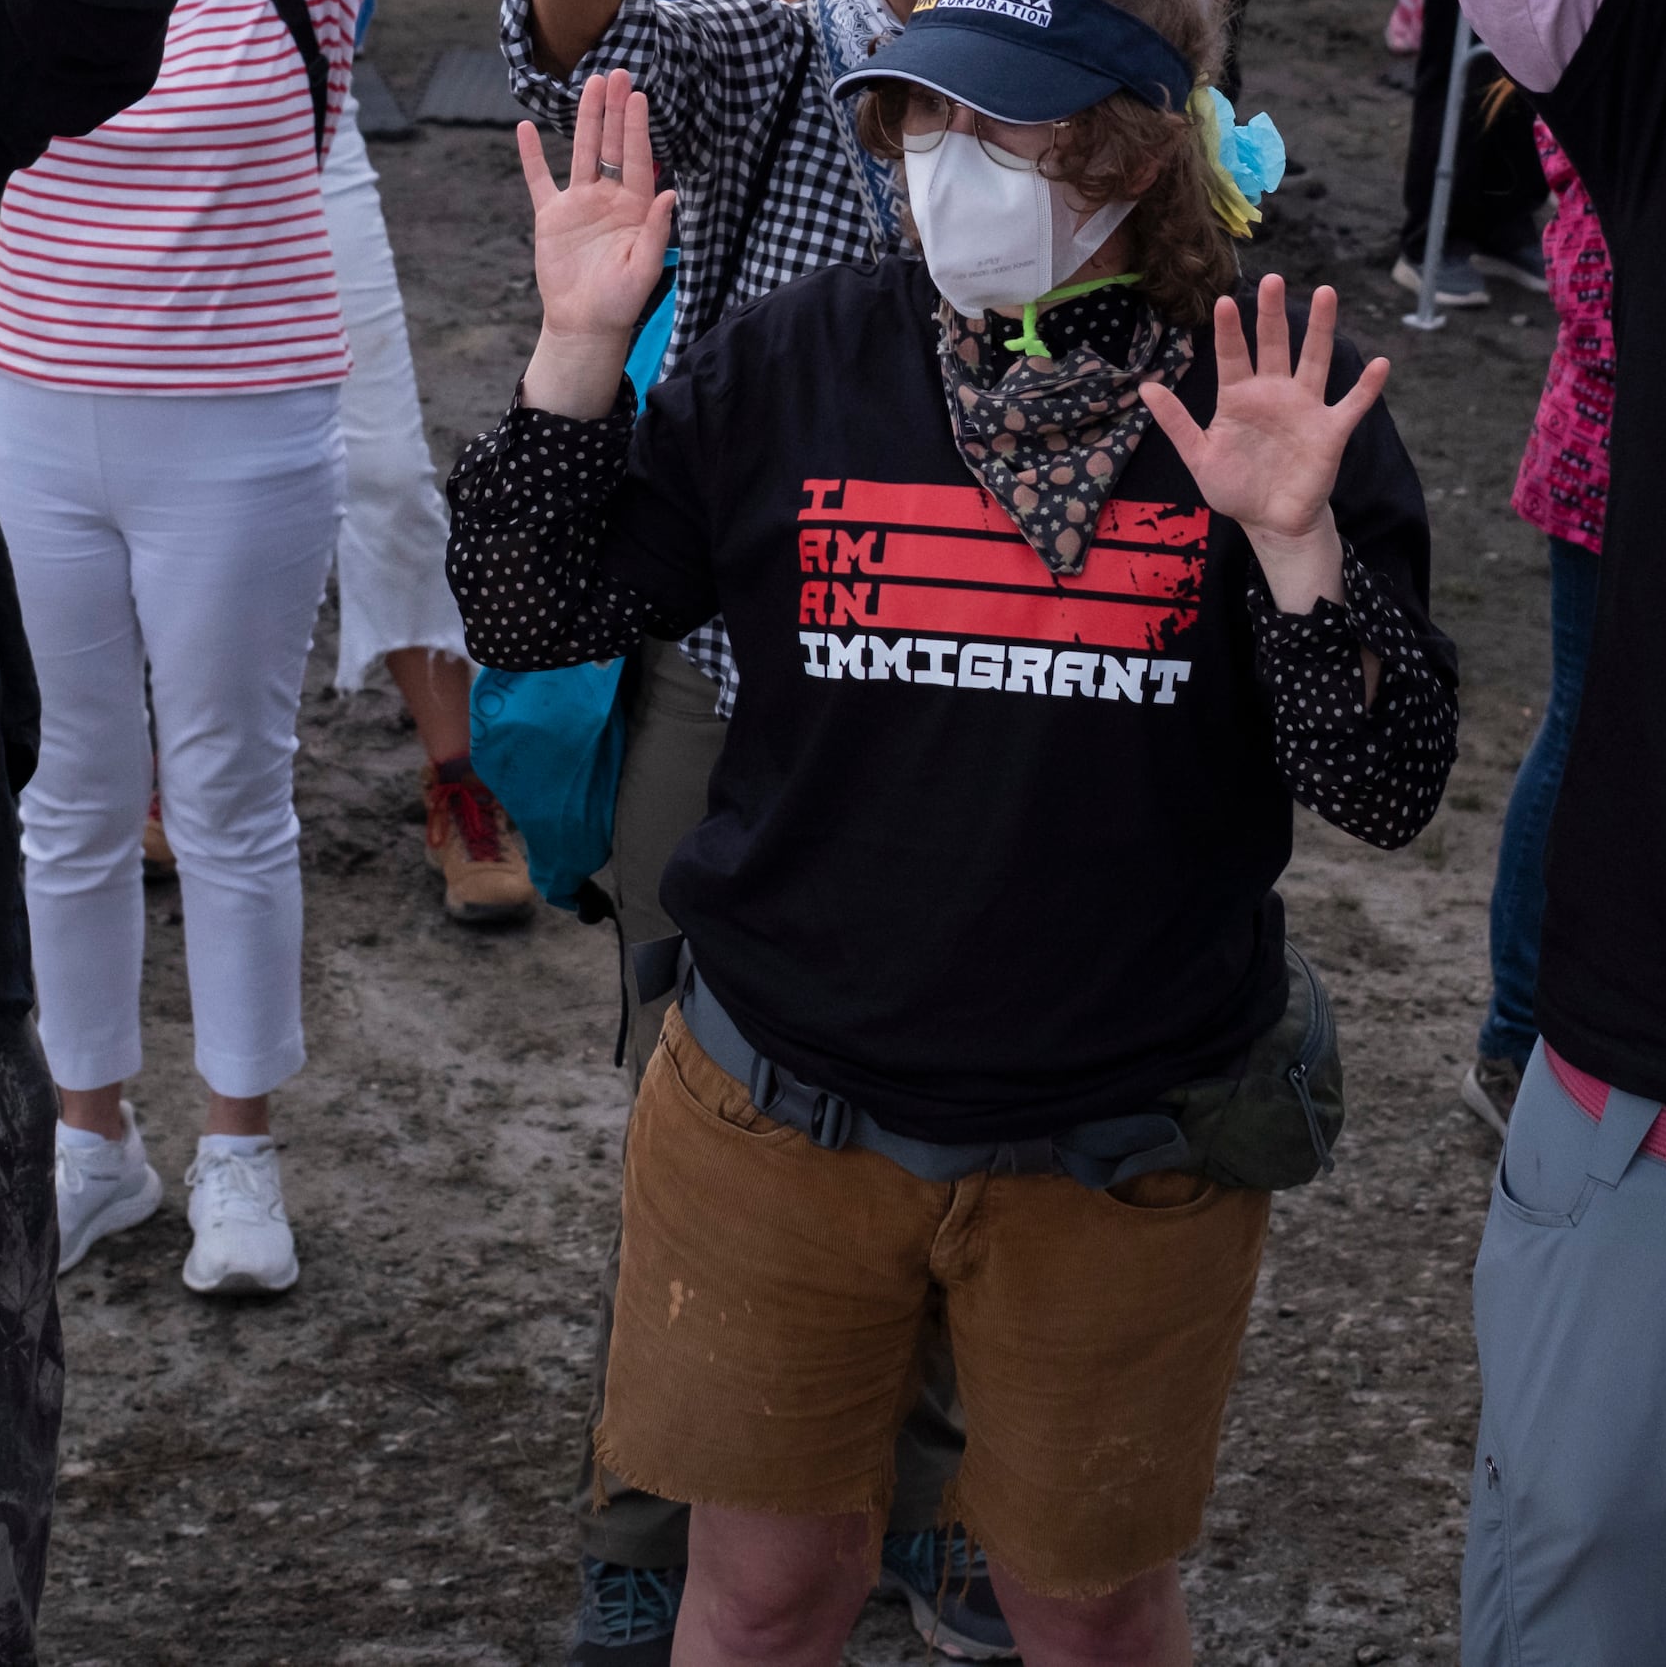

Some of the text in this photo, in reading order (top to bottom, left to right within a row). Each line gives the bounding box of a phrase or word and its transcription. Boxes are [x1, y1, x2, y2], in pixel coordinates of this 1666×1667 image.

[799, 529, 885, 575] AM
[799, 581, 880, 627] AN
[799, 631, 1192, 705] IMMIGRANT
